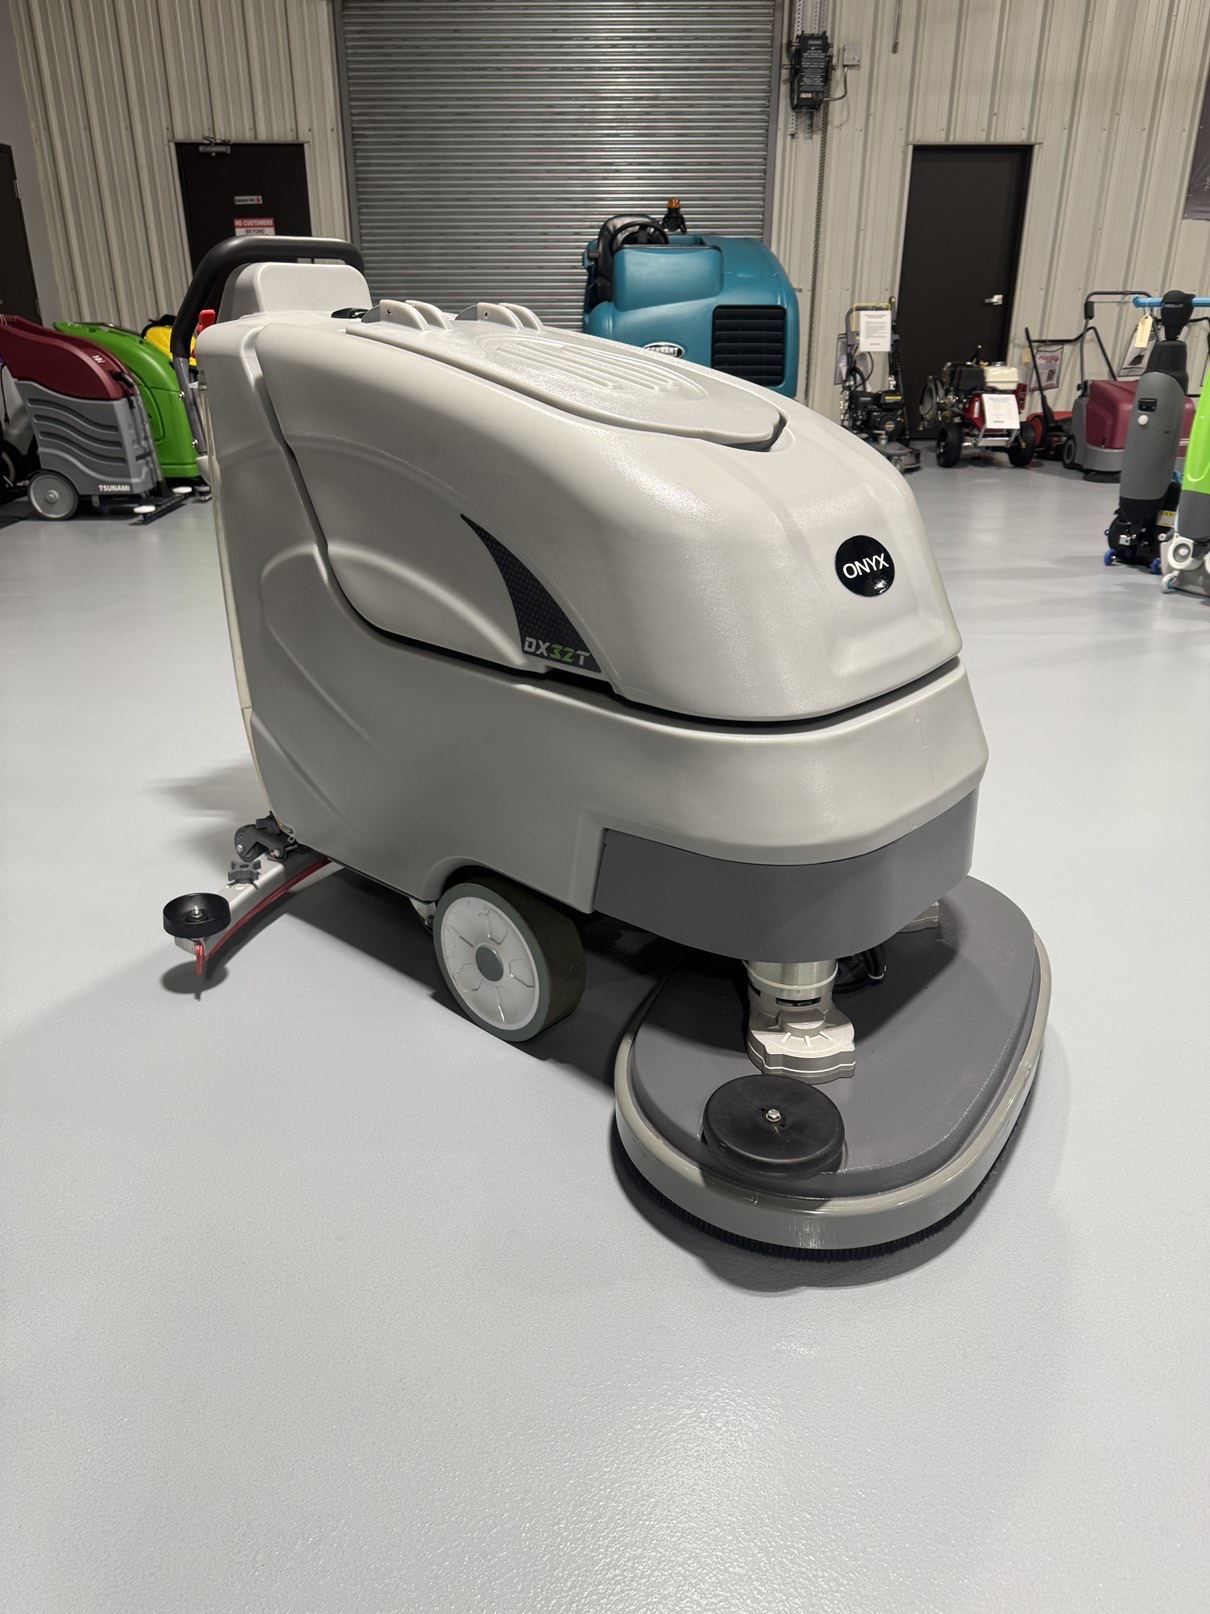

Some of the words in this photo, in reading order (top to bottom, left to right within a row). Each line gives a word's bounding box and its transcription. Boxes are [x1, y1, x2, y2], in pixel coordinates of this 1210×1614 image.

[98, 484, 131, 492] TSUNAMI
[842, 552, 890, 579] ONYX
[523, 636, 591, 666] DX32T
